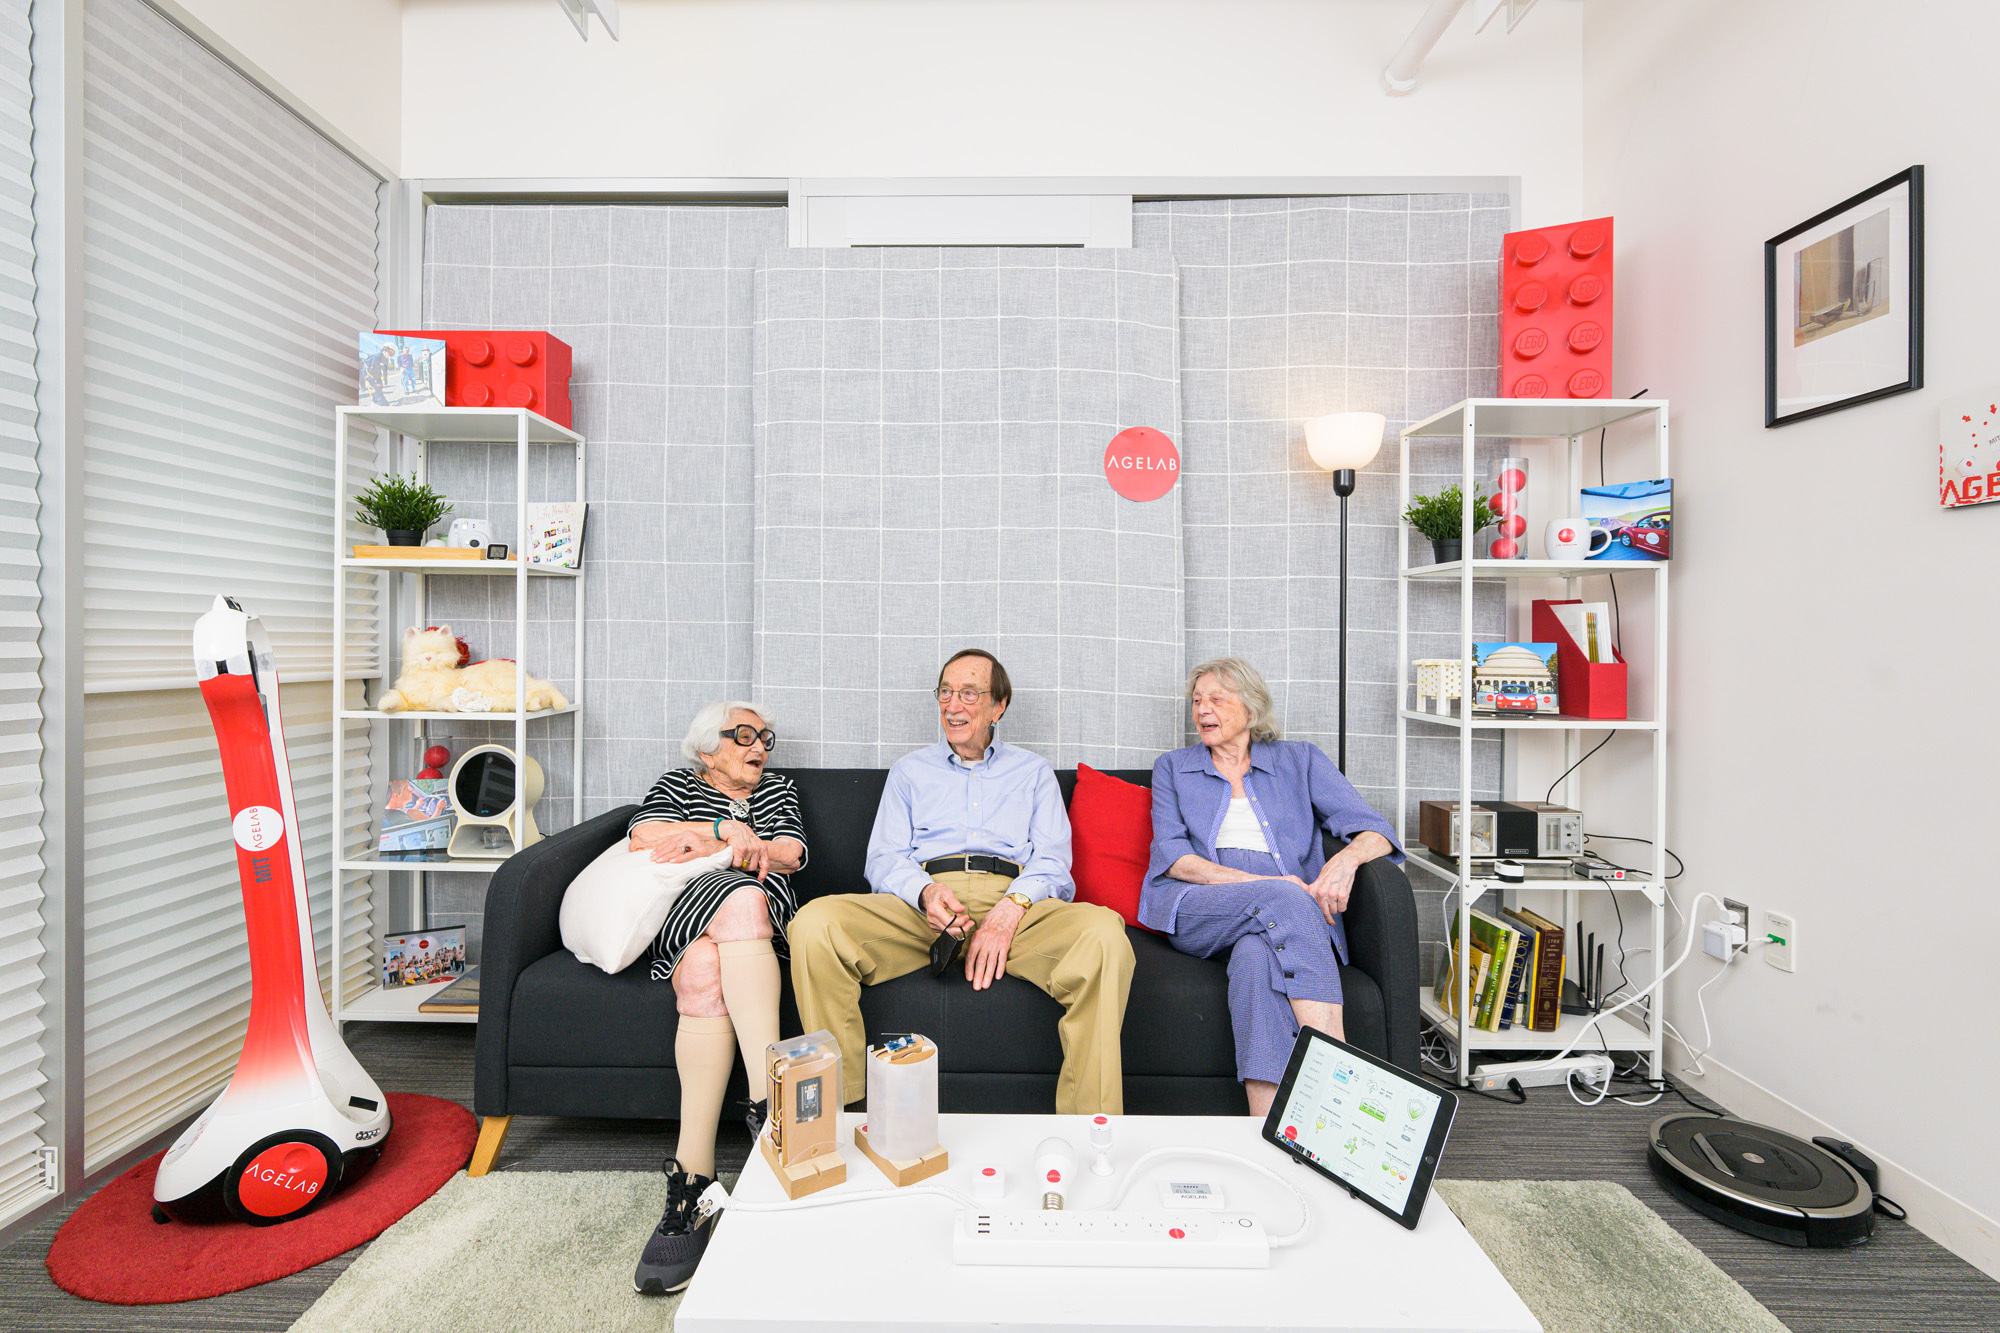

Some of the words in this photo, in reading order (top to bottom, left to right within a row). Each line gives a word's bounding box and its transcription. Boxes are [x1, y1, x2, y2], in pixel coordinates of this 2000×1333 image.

[1518, 334, 1545, 350] LEGO
[1571, 328, 1600, 344] LEGO
[1517, 381, 1544, 396] LEGO
[1571, 375, 1600, 391] LEGO
[1107, 455, 1177, 471] AGELAB
[249, 807, 263, 849] AGELAB
[252, 857, 273, 883] MIT
[1491, 959, 1501, 988] BEAUTIFUL
[1485, 989, 1495, 1016] EVIDENCE
[245, 1163, 318, 1194] AGELAB
